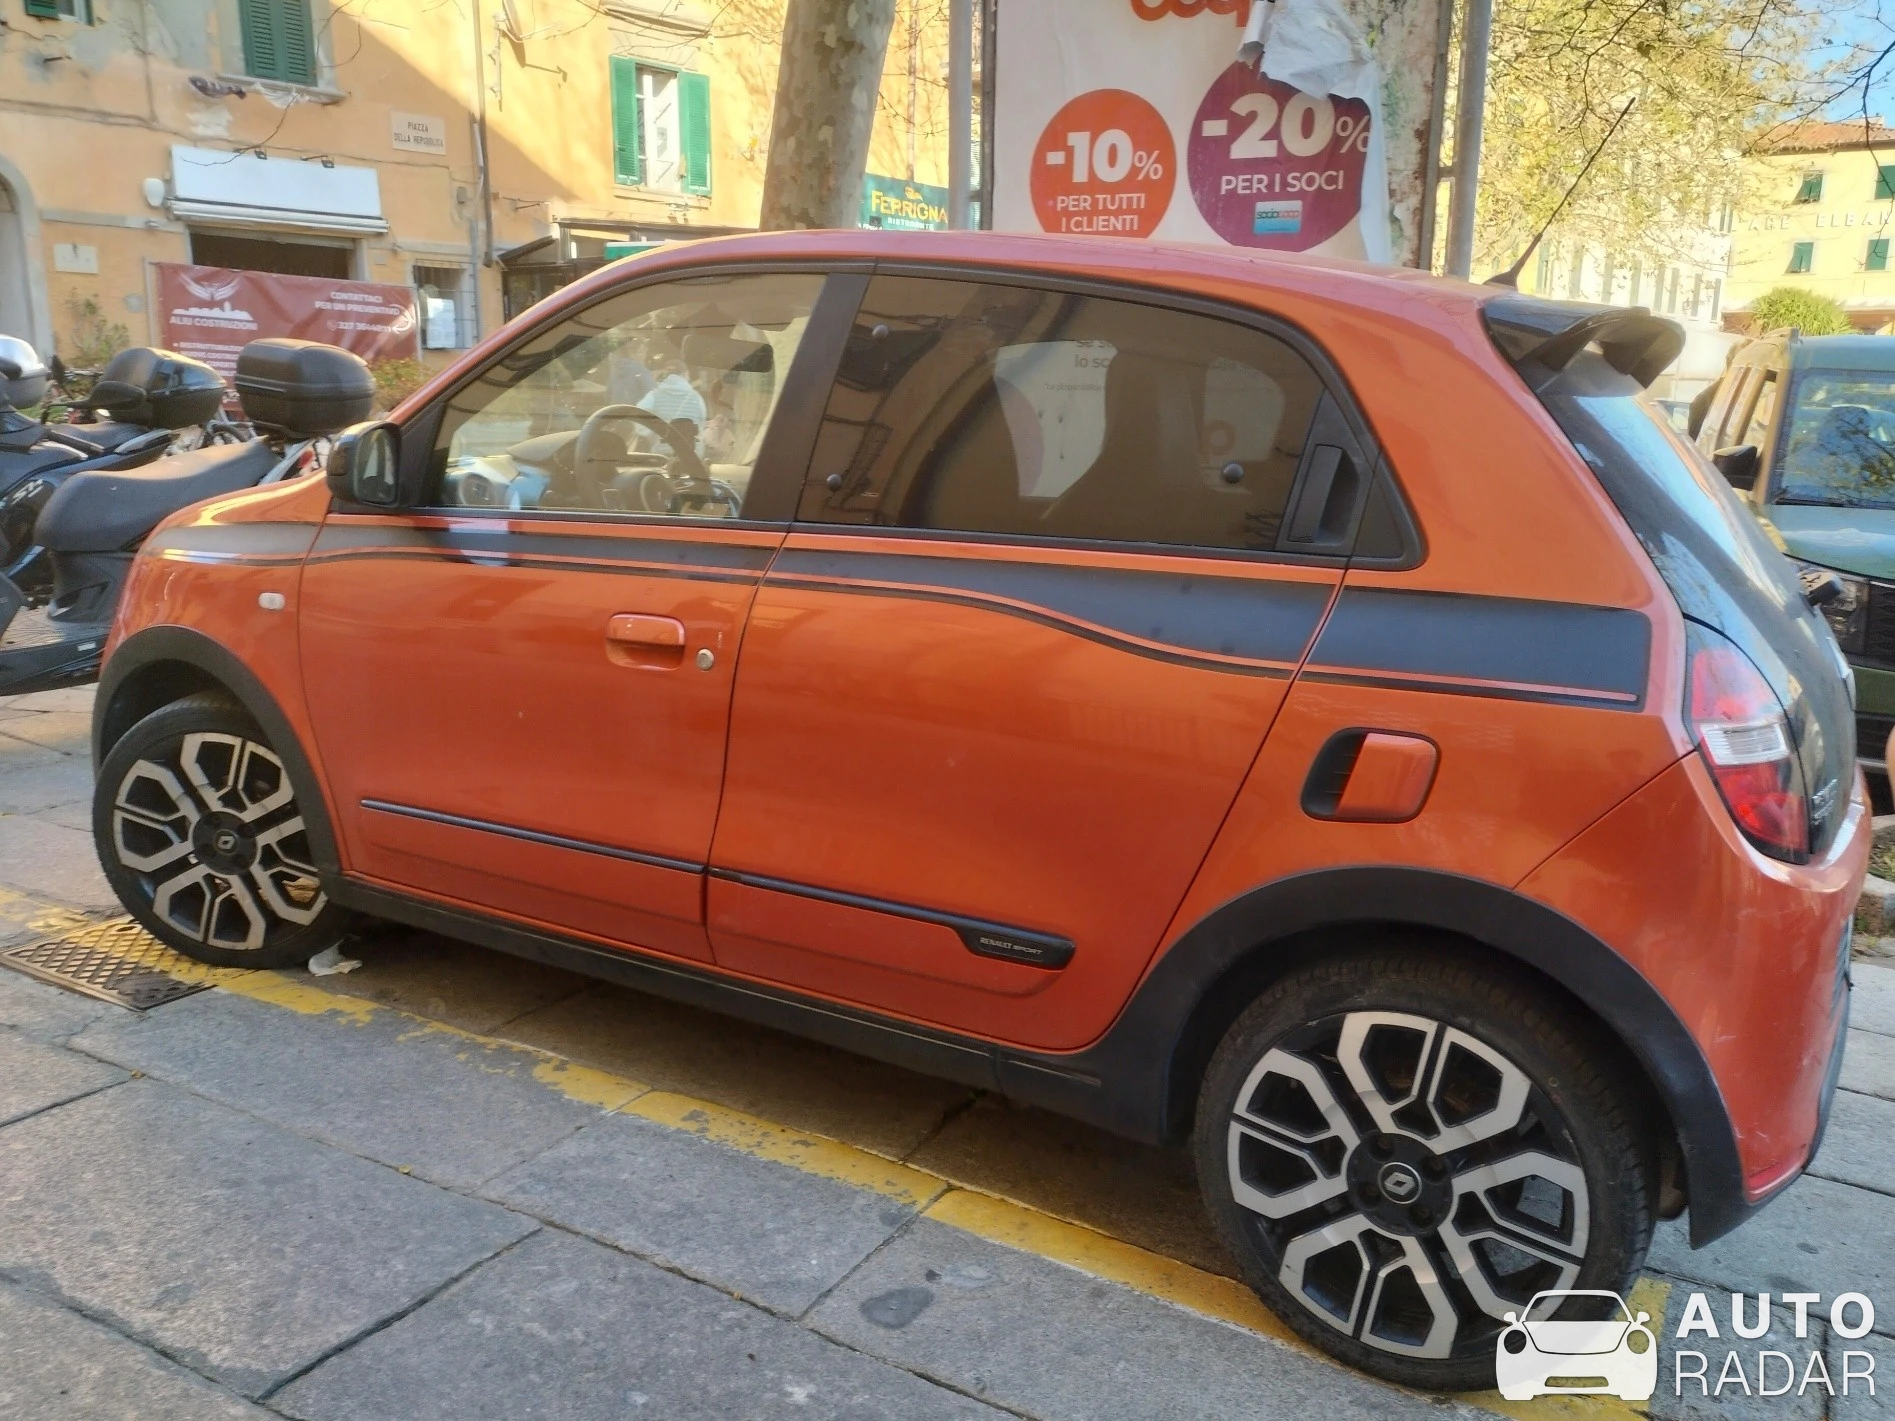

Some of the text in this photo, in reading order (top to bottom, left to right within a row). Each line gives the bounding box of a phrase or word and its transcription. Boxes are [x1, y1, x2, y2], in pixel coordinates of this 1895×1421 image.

[407, 121, 429, 132] PIAZZA
[1202, 93, 1371, 159] -20%
[394, 132, 444, 148] DELLA REPUBBLICA
[1046, 129, 1163, 182] -10%
[1220, 170, 1344, 195] PER I SOCI
[871, 190, 948, 224] FERRIGNA
[1056, 193, 1146, 211] PER TUTTI
[1061, 215, 1139, 232] I CLIENTI
[330, 291, 383, 303] CONTATTACI
[314, 300, 400, 316] PER UN PREVENTIVO
[194, 317, 259, 331] COSTRUZIONI
[1012, 944, 1043, 955] SPORT
